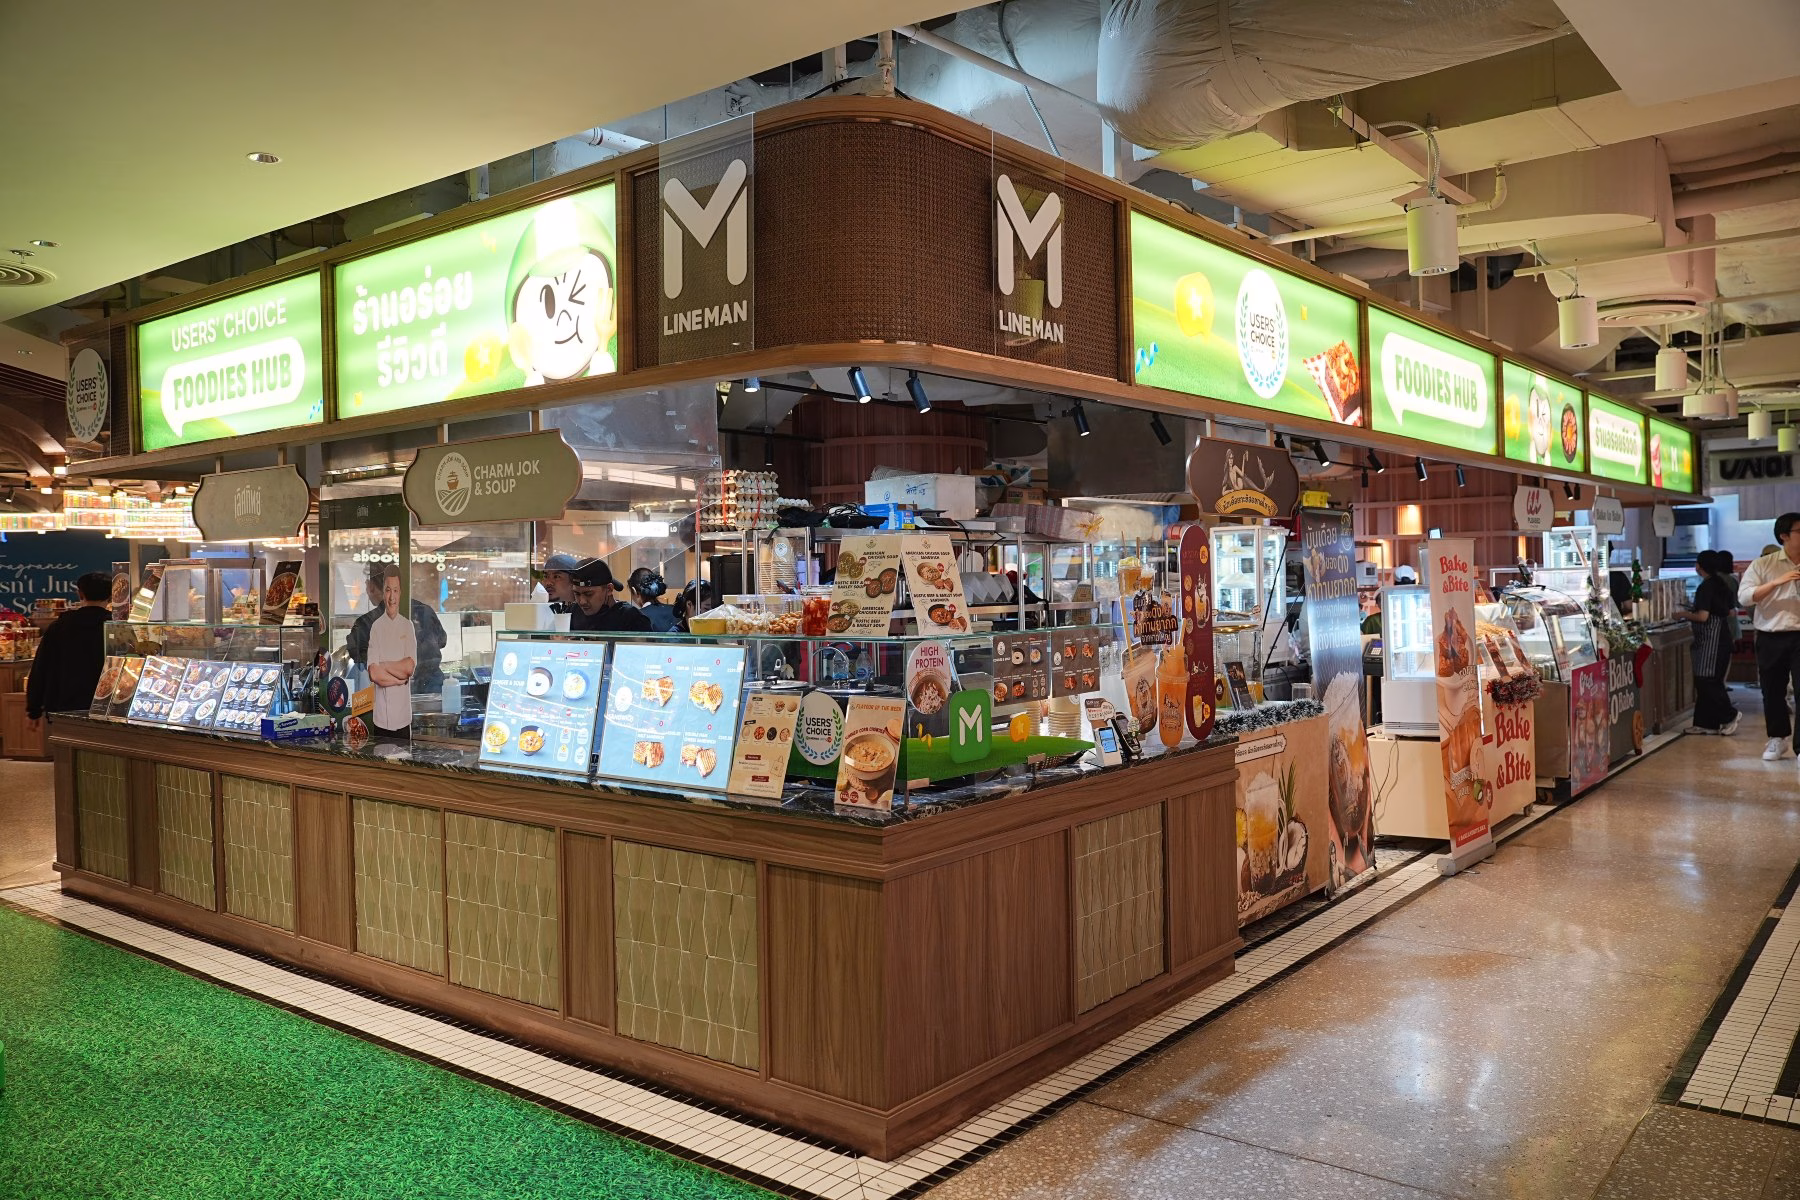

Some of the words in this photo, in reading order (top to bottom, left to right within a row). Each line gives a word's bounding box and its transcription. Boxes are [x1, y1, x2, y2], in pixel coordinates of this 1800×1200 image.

[663, 158, 748, 300] M
[997, 174, 1062, 309] M
[352, 264, 474, 336] ร้านอร่อย
[223, 296, 288, 339] CHOICE
[1250, 329, 1275, 348] CHOICE
[376, 321, 449, 388] รีวิวดี
[173, 363, 247, 411] FOODIES
[252, 353, 291, 395] HUB
[1395, 354, 1452, 406] FOODIES
[1454, 373, 1478, 413] HUB
[76, 391, 97, 405] CHOICE
[473, 463, 515, 481] CHARM
[516, 460, 540, 477] JOK
[474, 483, 483, 496] &
[485, 479, 516, 495] SOUP
[0, 563, 78, 578] ragrance
[1440, 554, 1468, 574] Bake
[42, 576, 80, 593] Jus
[921, 646, 939, 656] HIGH
[916, 657, 944, 669] PROTEIN
[1608, 655, 1634, 692] Bake
[1618, 688, 1635, 713] Babe
[806, 727, 831, 736] CHOICE
[1495, 708, 1530, 748] Bake
